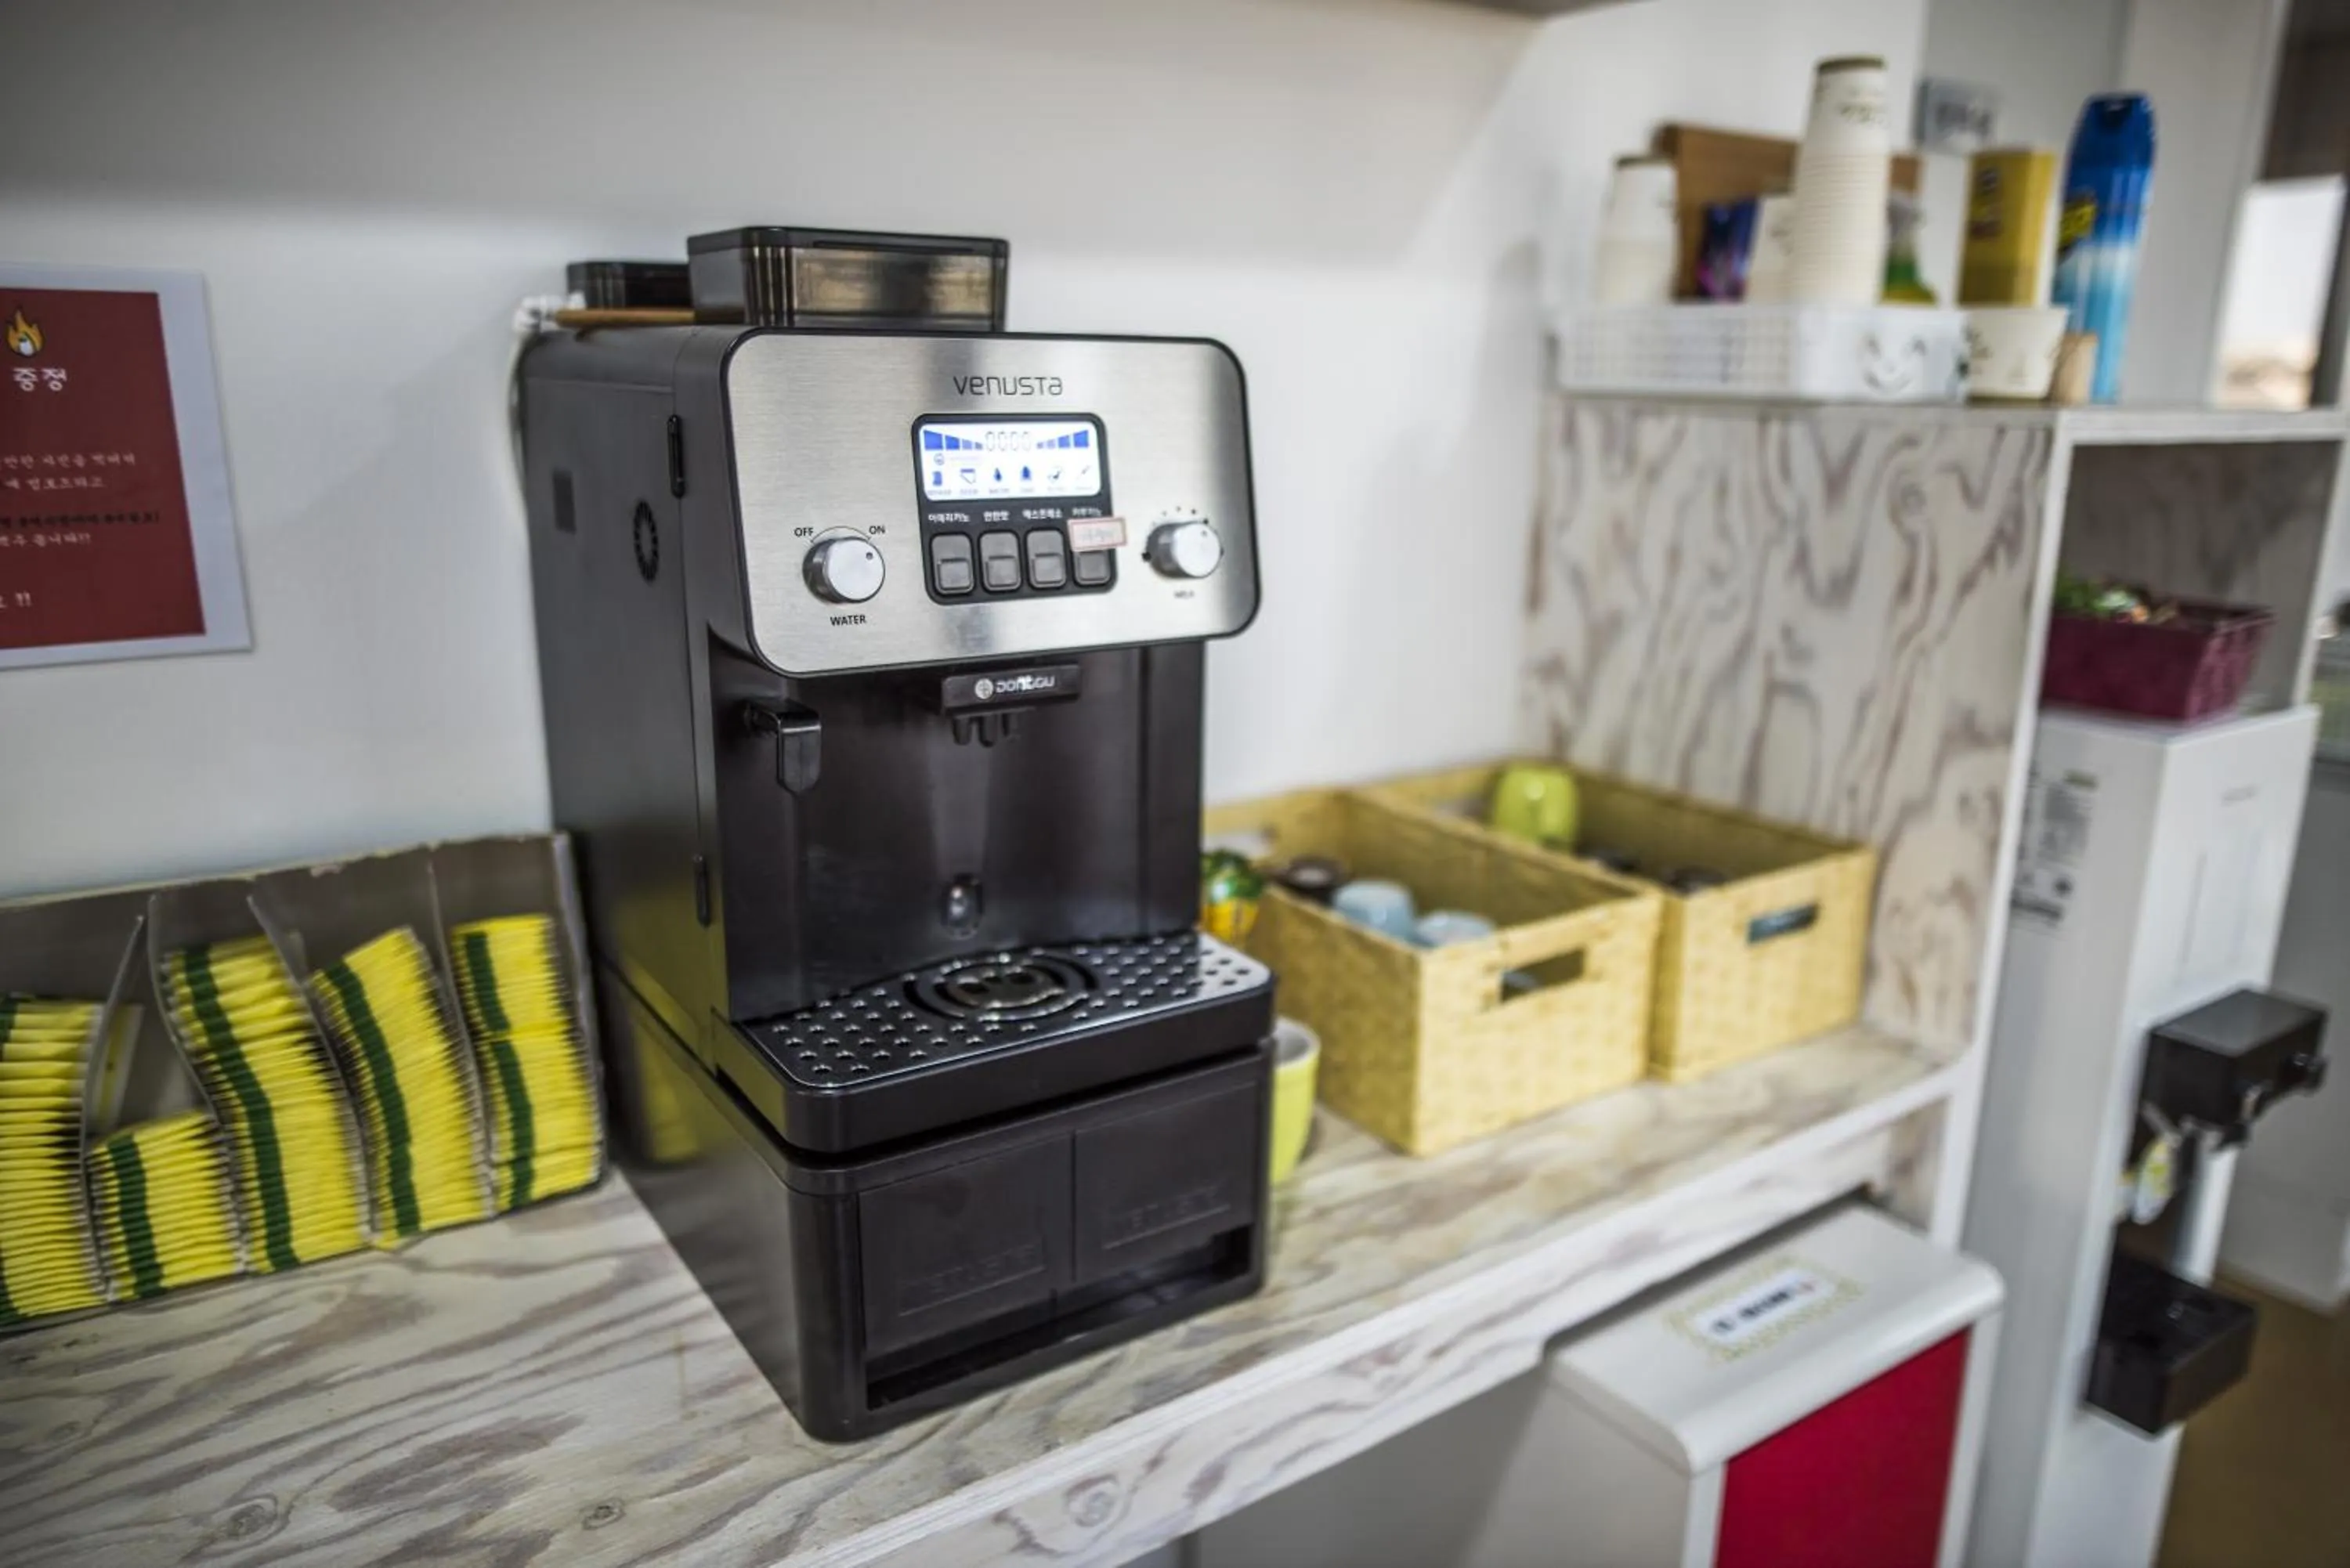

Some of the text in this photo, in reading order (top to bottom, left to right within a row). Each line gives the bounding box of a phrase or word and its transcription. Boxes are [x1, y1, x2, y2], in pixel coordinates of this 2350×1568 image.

[794, 527, 814, 537] OFF
[869, 526, 886, 535] ON
[830, 614, 867, 626] WATER
